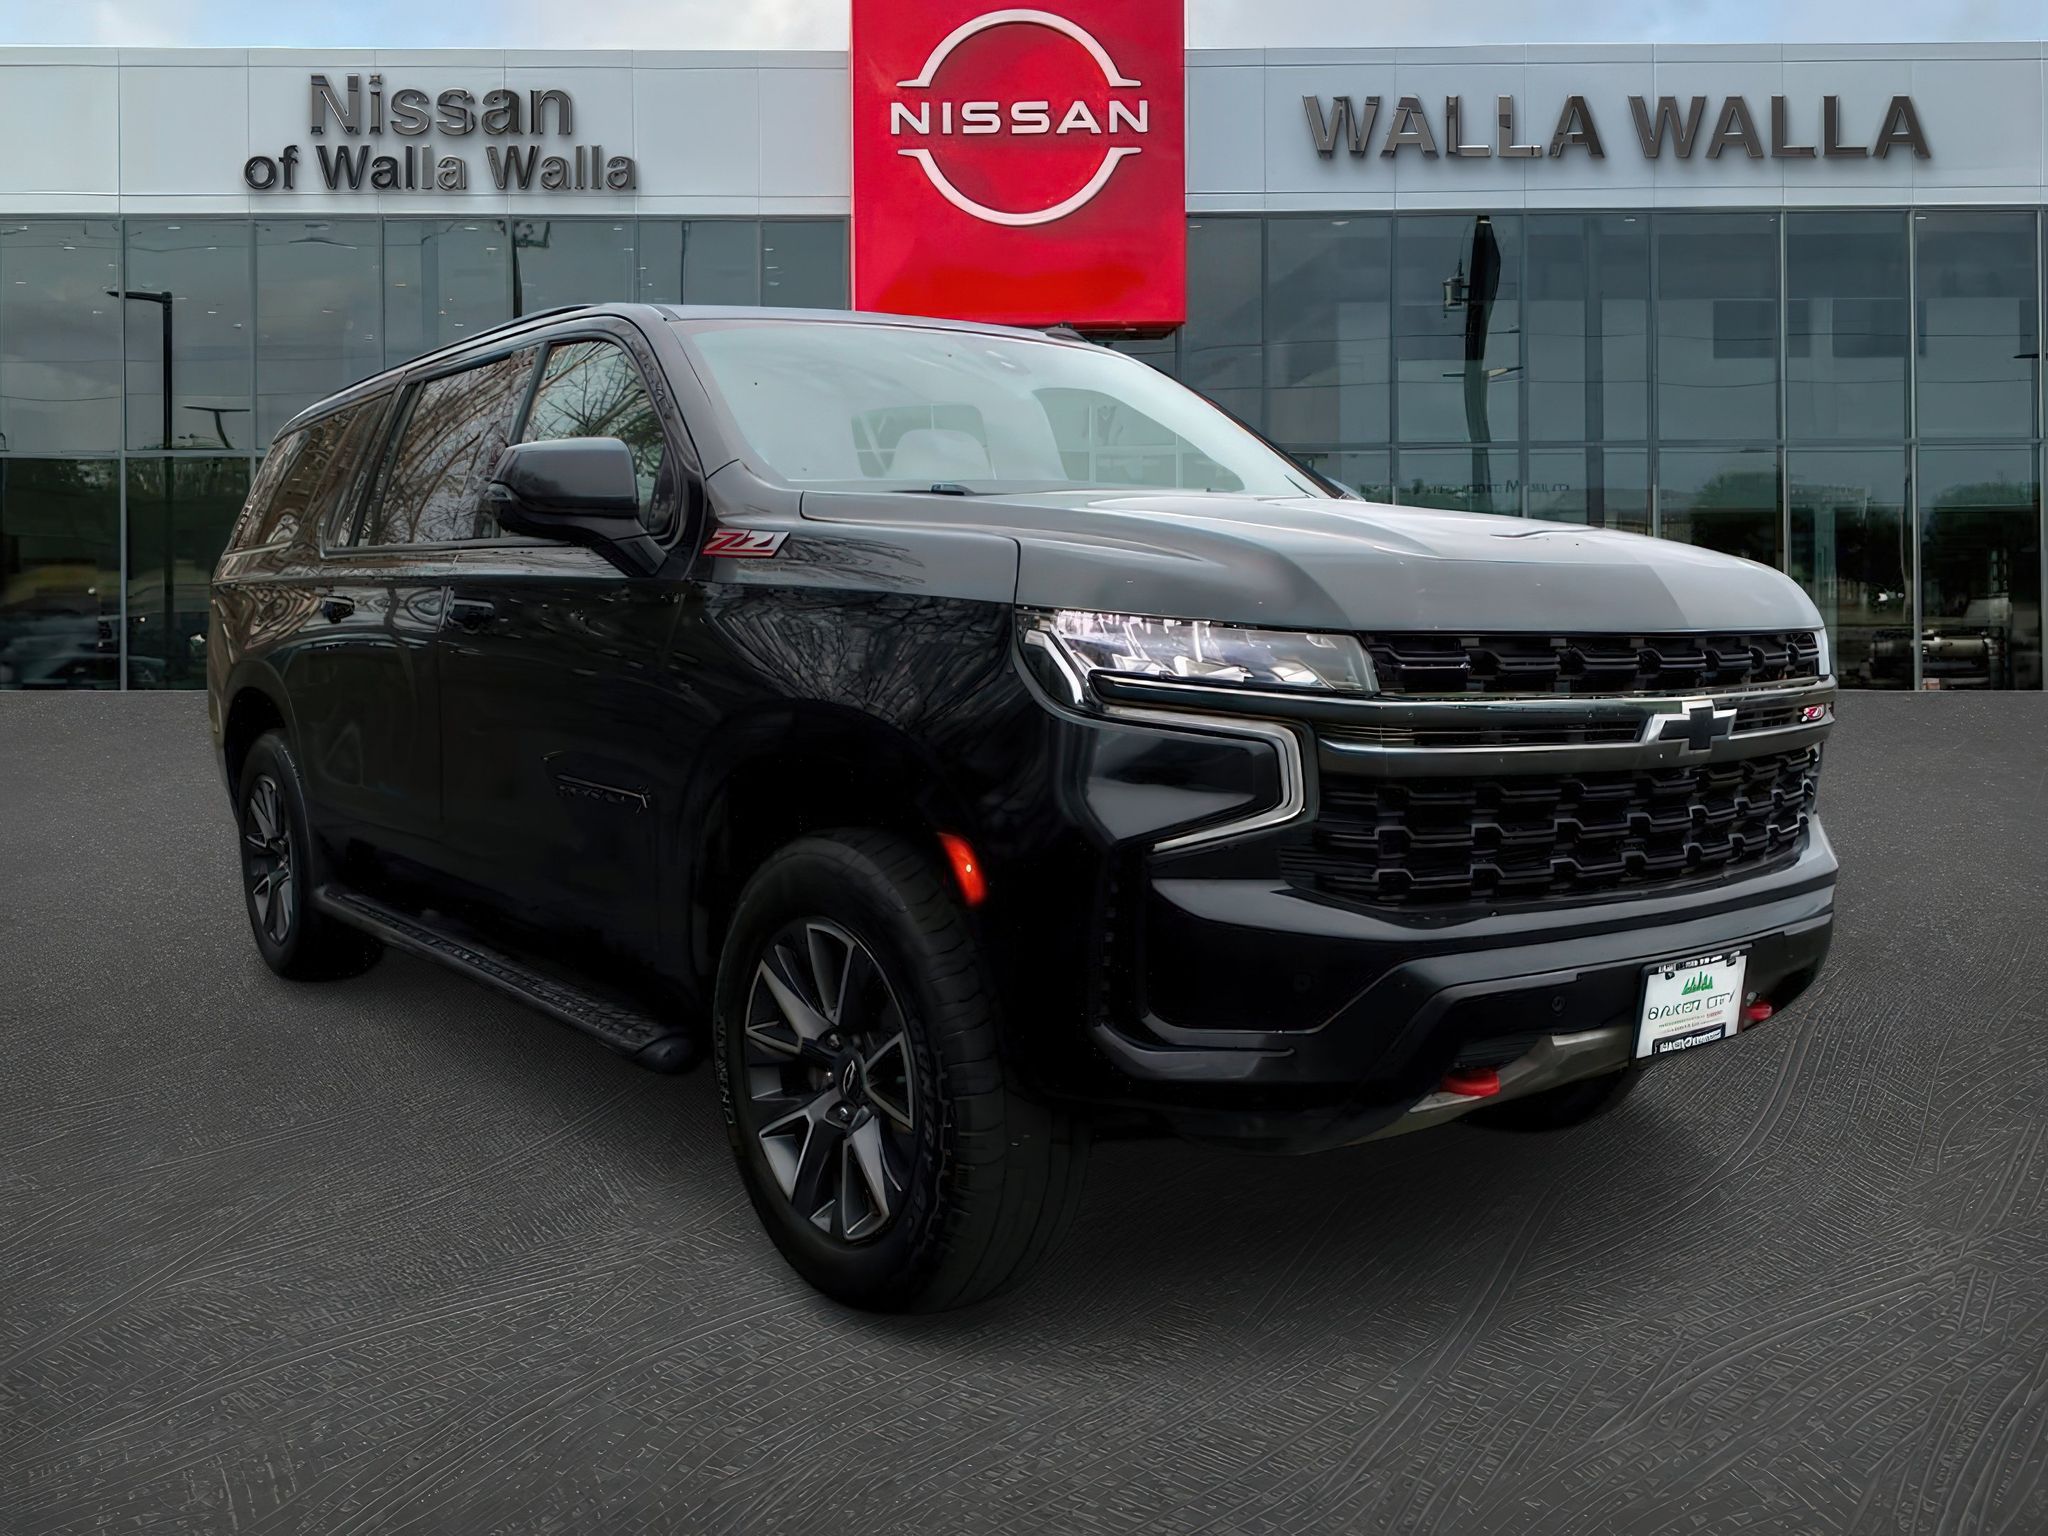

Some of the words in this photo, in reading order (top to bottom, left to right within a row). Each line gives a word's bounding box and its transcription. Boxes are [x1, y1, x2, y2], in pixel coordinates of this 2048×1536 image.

[310, 73, 574, 136] Nissan
[890, 100, 1149, 135] NISSAN
[1302, 94, 1605, 160] WALLA
[1628, 94, 1932, 160] WALLA
[243, 144, 300, 190] of
[315, 144, 468, 191] Walla
[485, 144, 638, 191] Walla
